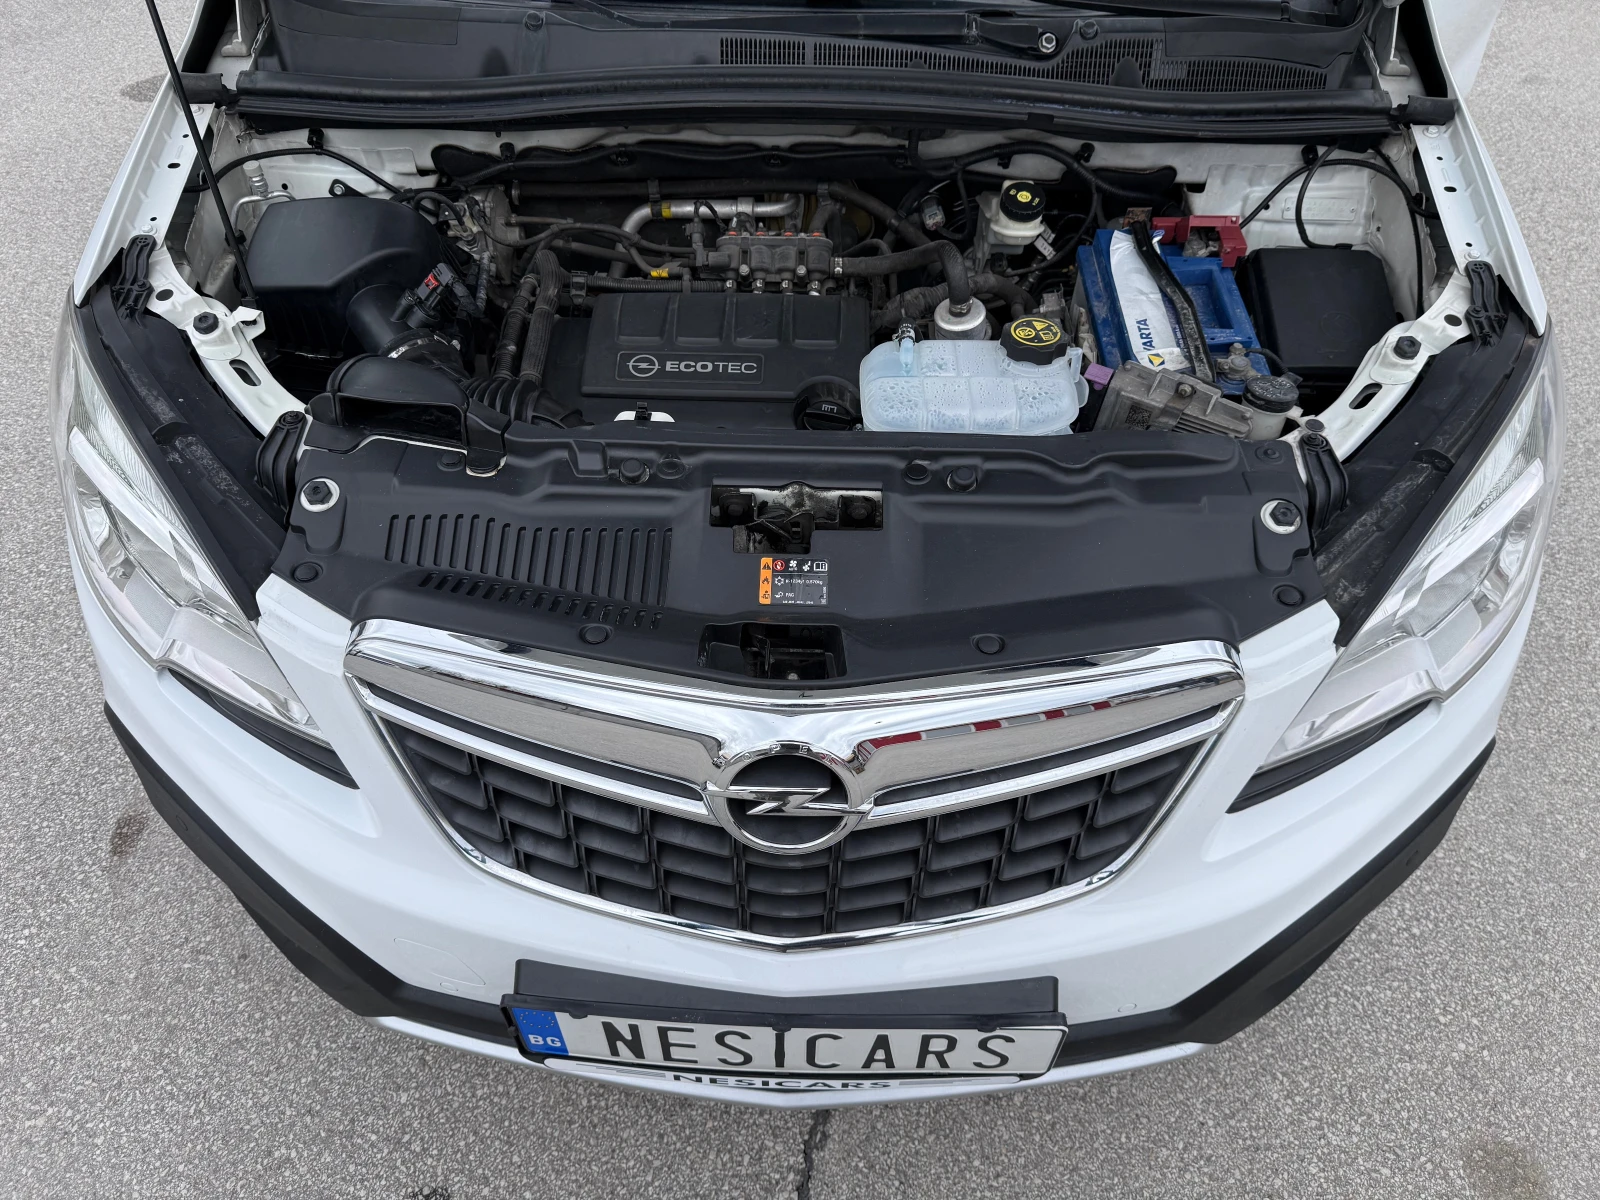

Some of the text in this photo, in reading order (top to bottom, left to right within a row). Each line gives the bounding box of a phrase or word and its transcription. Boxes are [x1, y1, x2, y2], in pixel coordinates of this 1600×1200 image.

[665, 361, 758, 374] ECOTEC
[528, 1021, 1016, 1069] BG NESICARS
[673, 1074, 891, 1089] NESICARS
